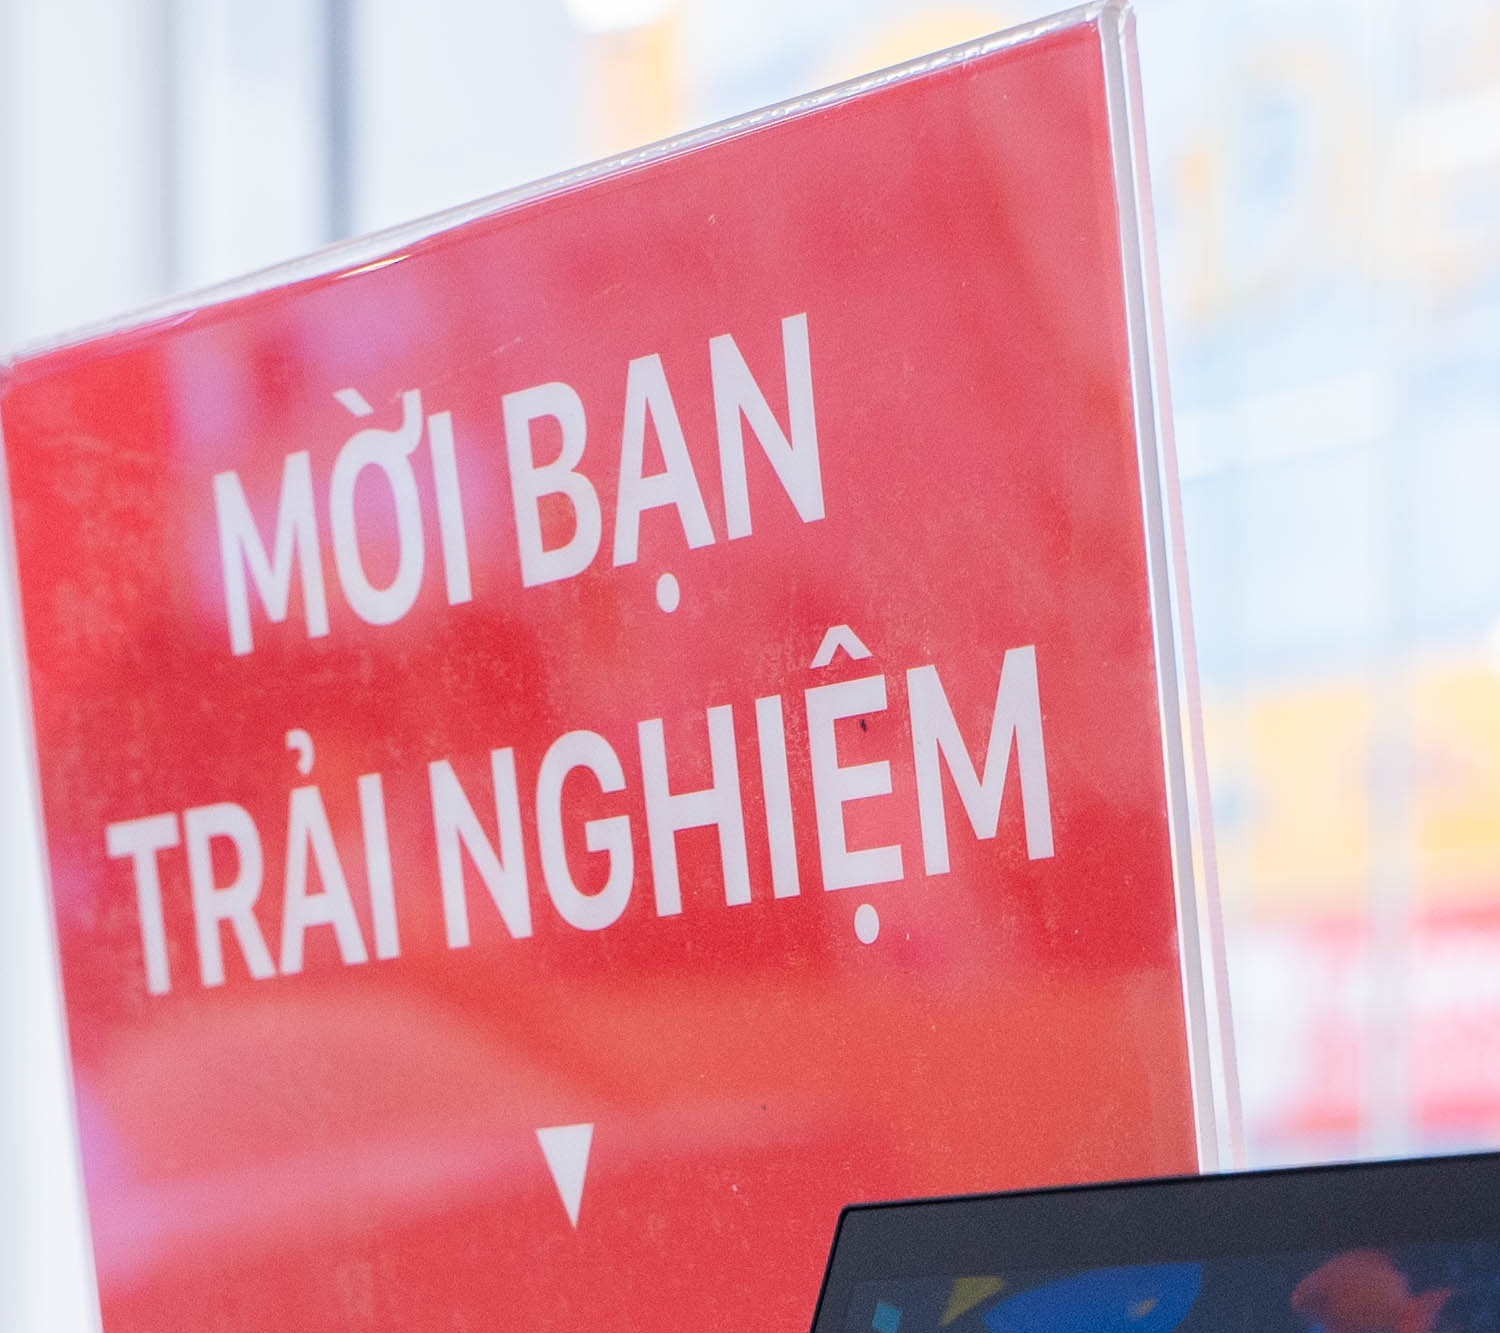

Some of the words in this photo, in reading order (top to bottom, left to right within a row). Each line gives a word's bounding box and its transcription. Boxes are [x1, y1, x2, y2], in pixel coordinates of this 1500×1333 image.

[213, 387, 474, 656] MỜI
[503, 313, 827, 614] BẠN
[105, 729, 399, 995] TRẢI
[428, 624, 1055, 947] NGHIỆM
